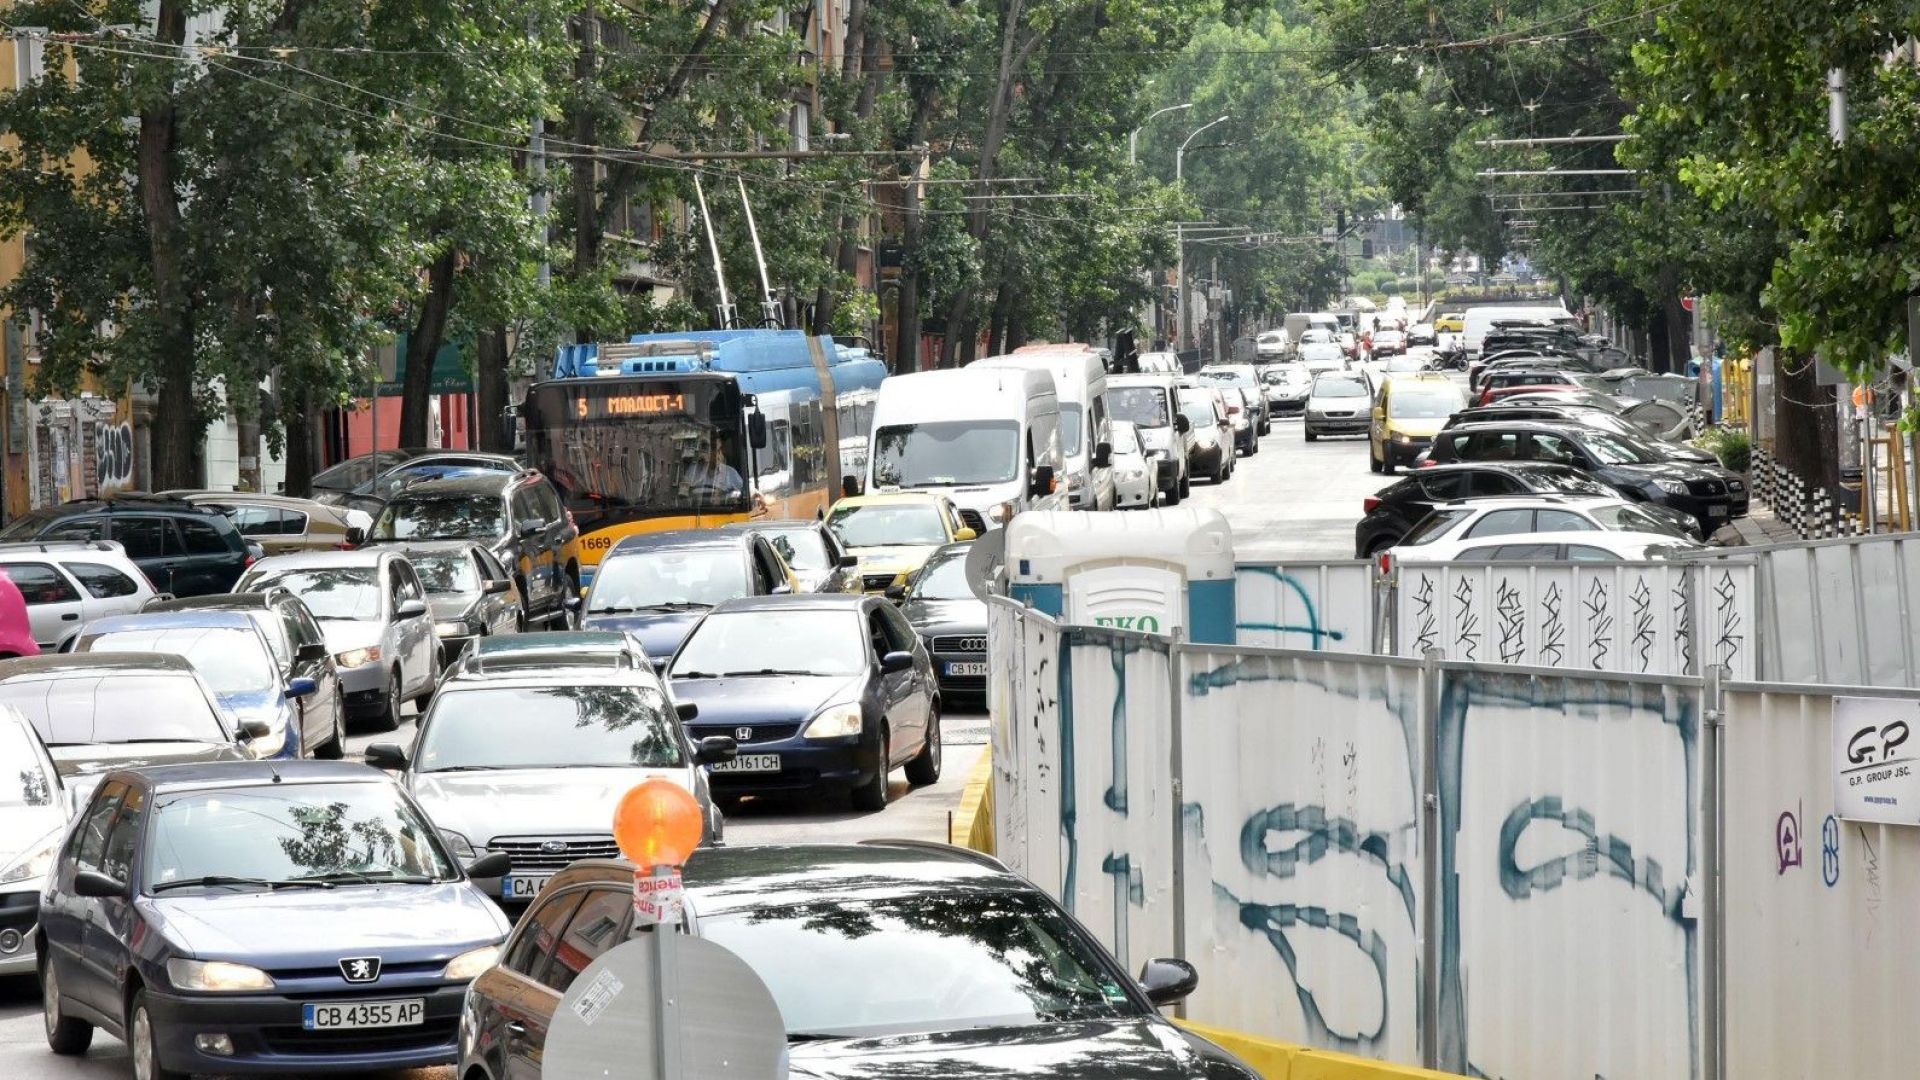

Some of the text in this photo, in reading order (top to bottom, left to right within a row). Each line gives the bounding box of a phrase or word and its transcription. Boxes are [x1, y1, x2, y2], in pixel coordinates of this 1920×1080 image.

[578, 395, 684, 416] 5 МЛАДОСТ-1
[580, 537, 611, 550] 1669
[951, 663, 987, 674] CB 191
[1849, 766, 1911, 786] G.P. GROUP JSC.
[514, 879, 535, 895] CA
[317, 1003, 421, 1026] CB 4355 AP
